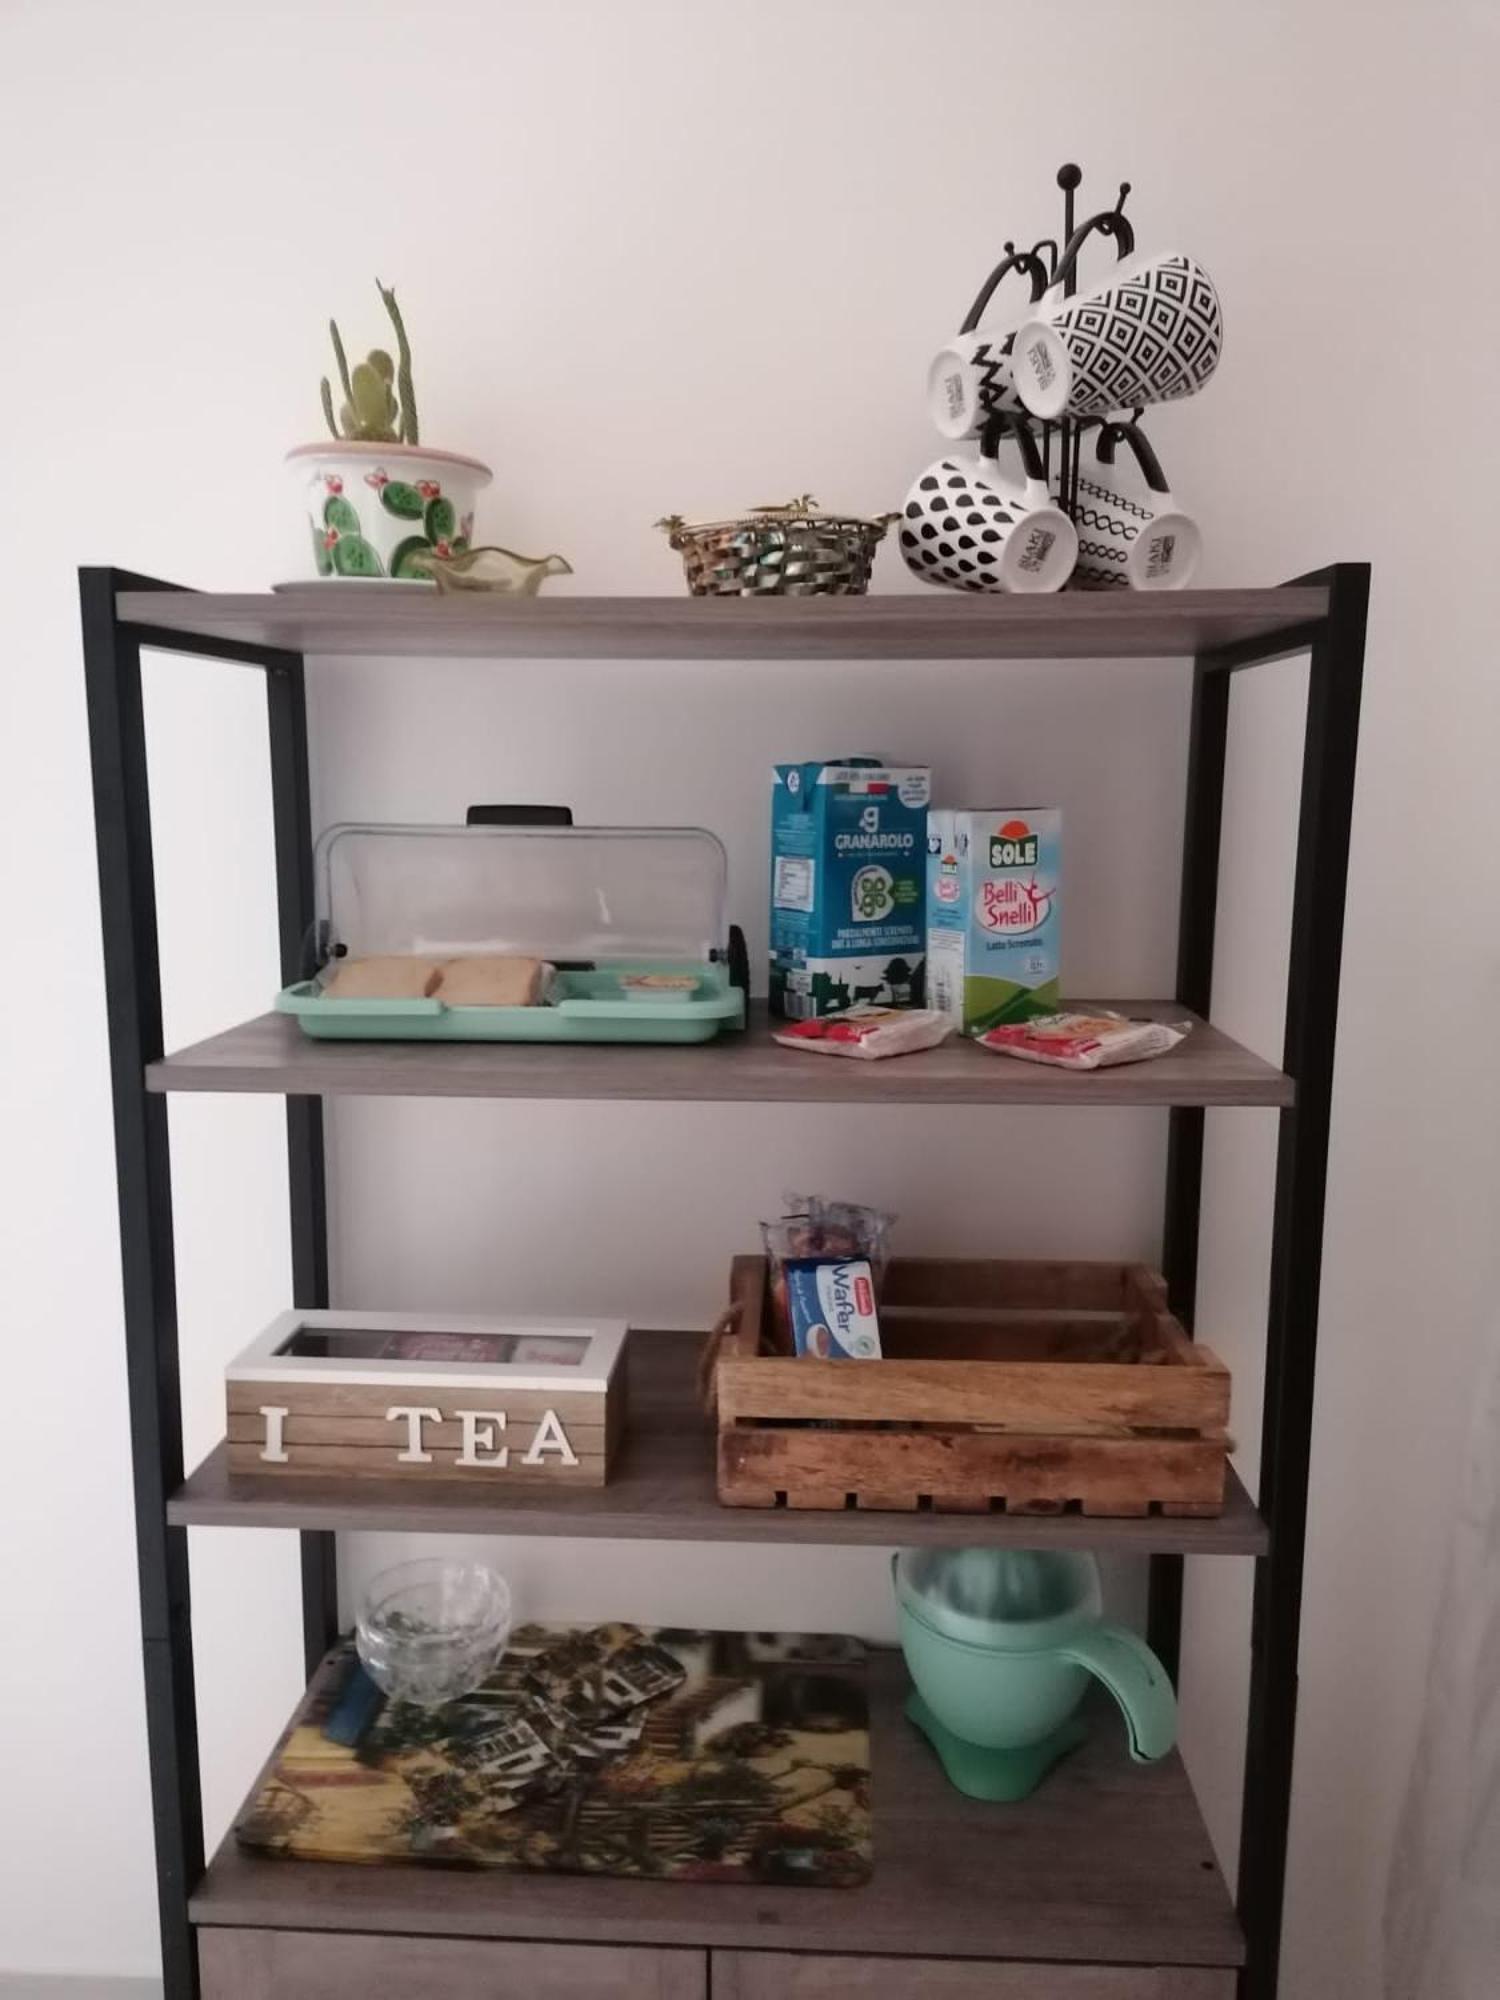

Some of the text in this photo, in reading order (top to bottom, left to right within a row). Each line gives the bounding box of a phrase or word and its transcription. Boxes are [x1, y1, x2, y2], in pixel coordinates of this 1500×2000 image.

[834, 833, 914, 850] GRANAROLO
[991, 842, 1036, 866] SOLE
[984, 880, 1018, 906] Belli
[987, 902, 1033, 927] Snelli
[832, 1264, 855, 1334] Wafer
[259, 1405, 579, 1468] I TEA
